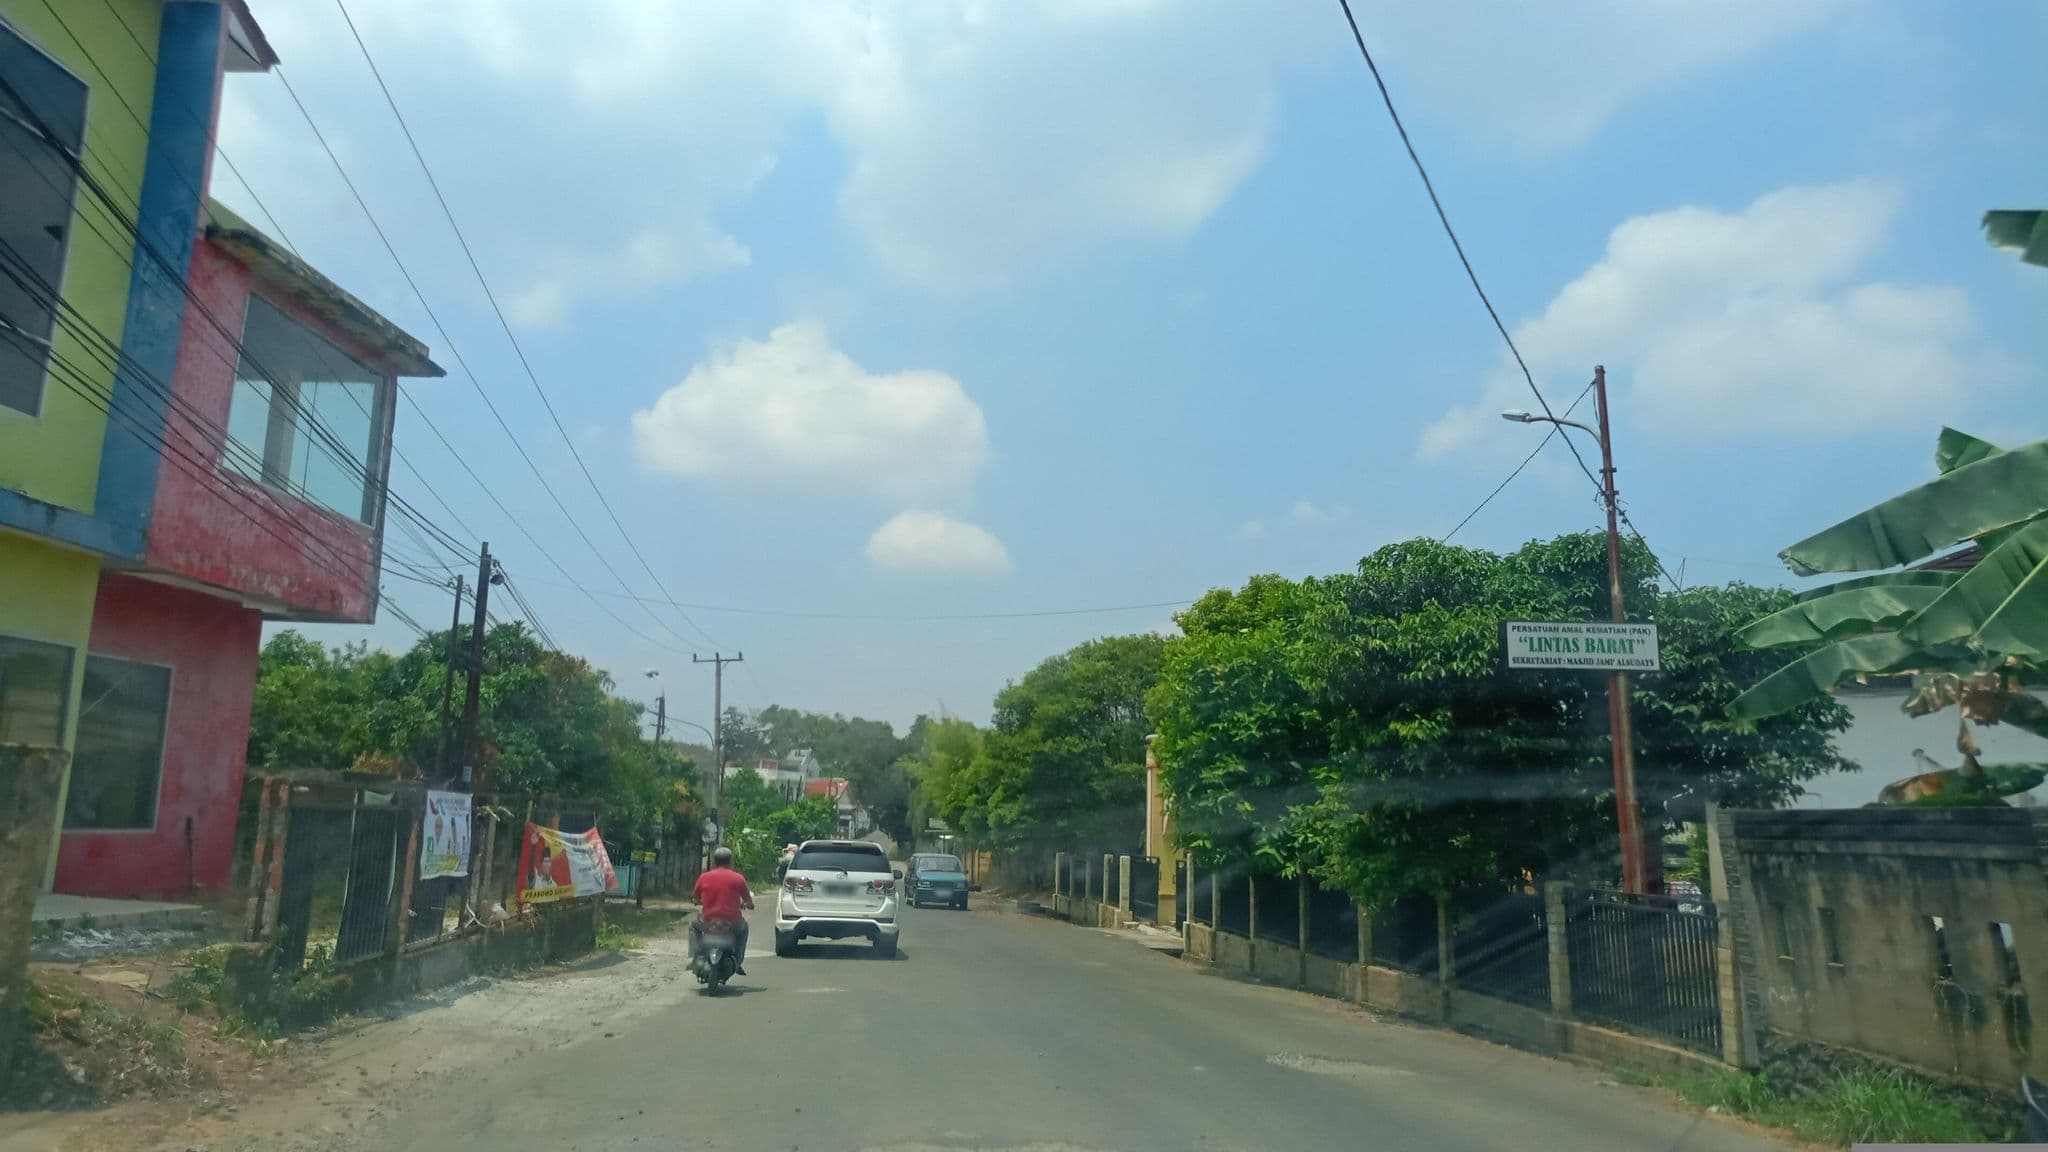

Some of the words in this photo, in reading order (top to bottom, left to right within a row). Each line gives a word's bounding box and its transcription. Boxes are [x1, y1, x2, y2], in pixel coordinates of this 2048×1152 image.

[1511, 625, 1559, 633] PERSATUAN
[1629, 627, 1651, 636] (PAK)
[1567, 657, 1594, 665] MASJID
